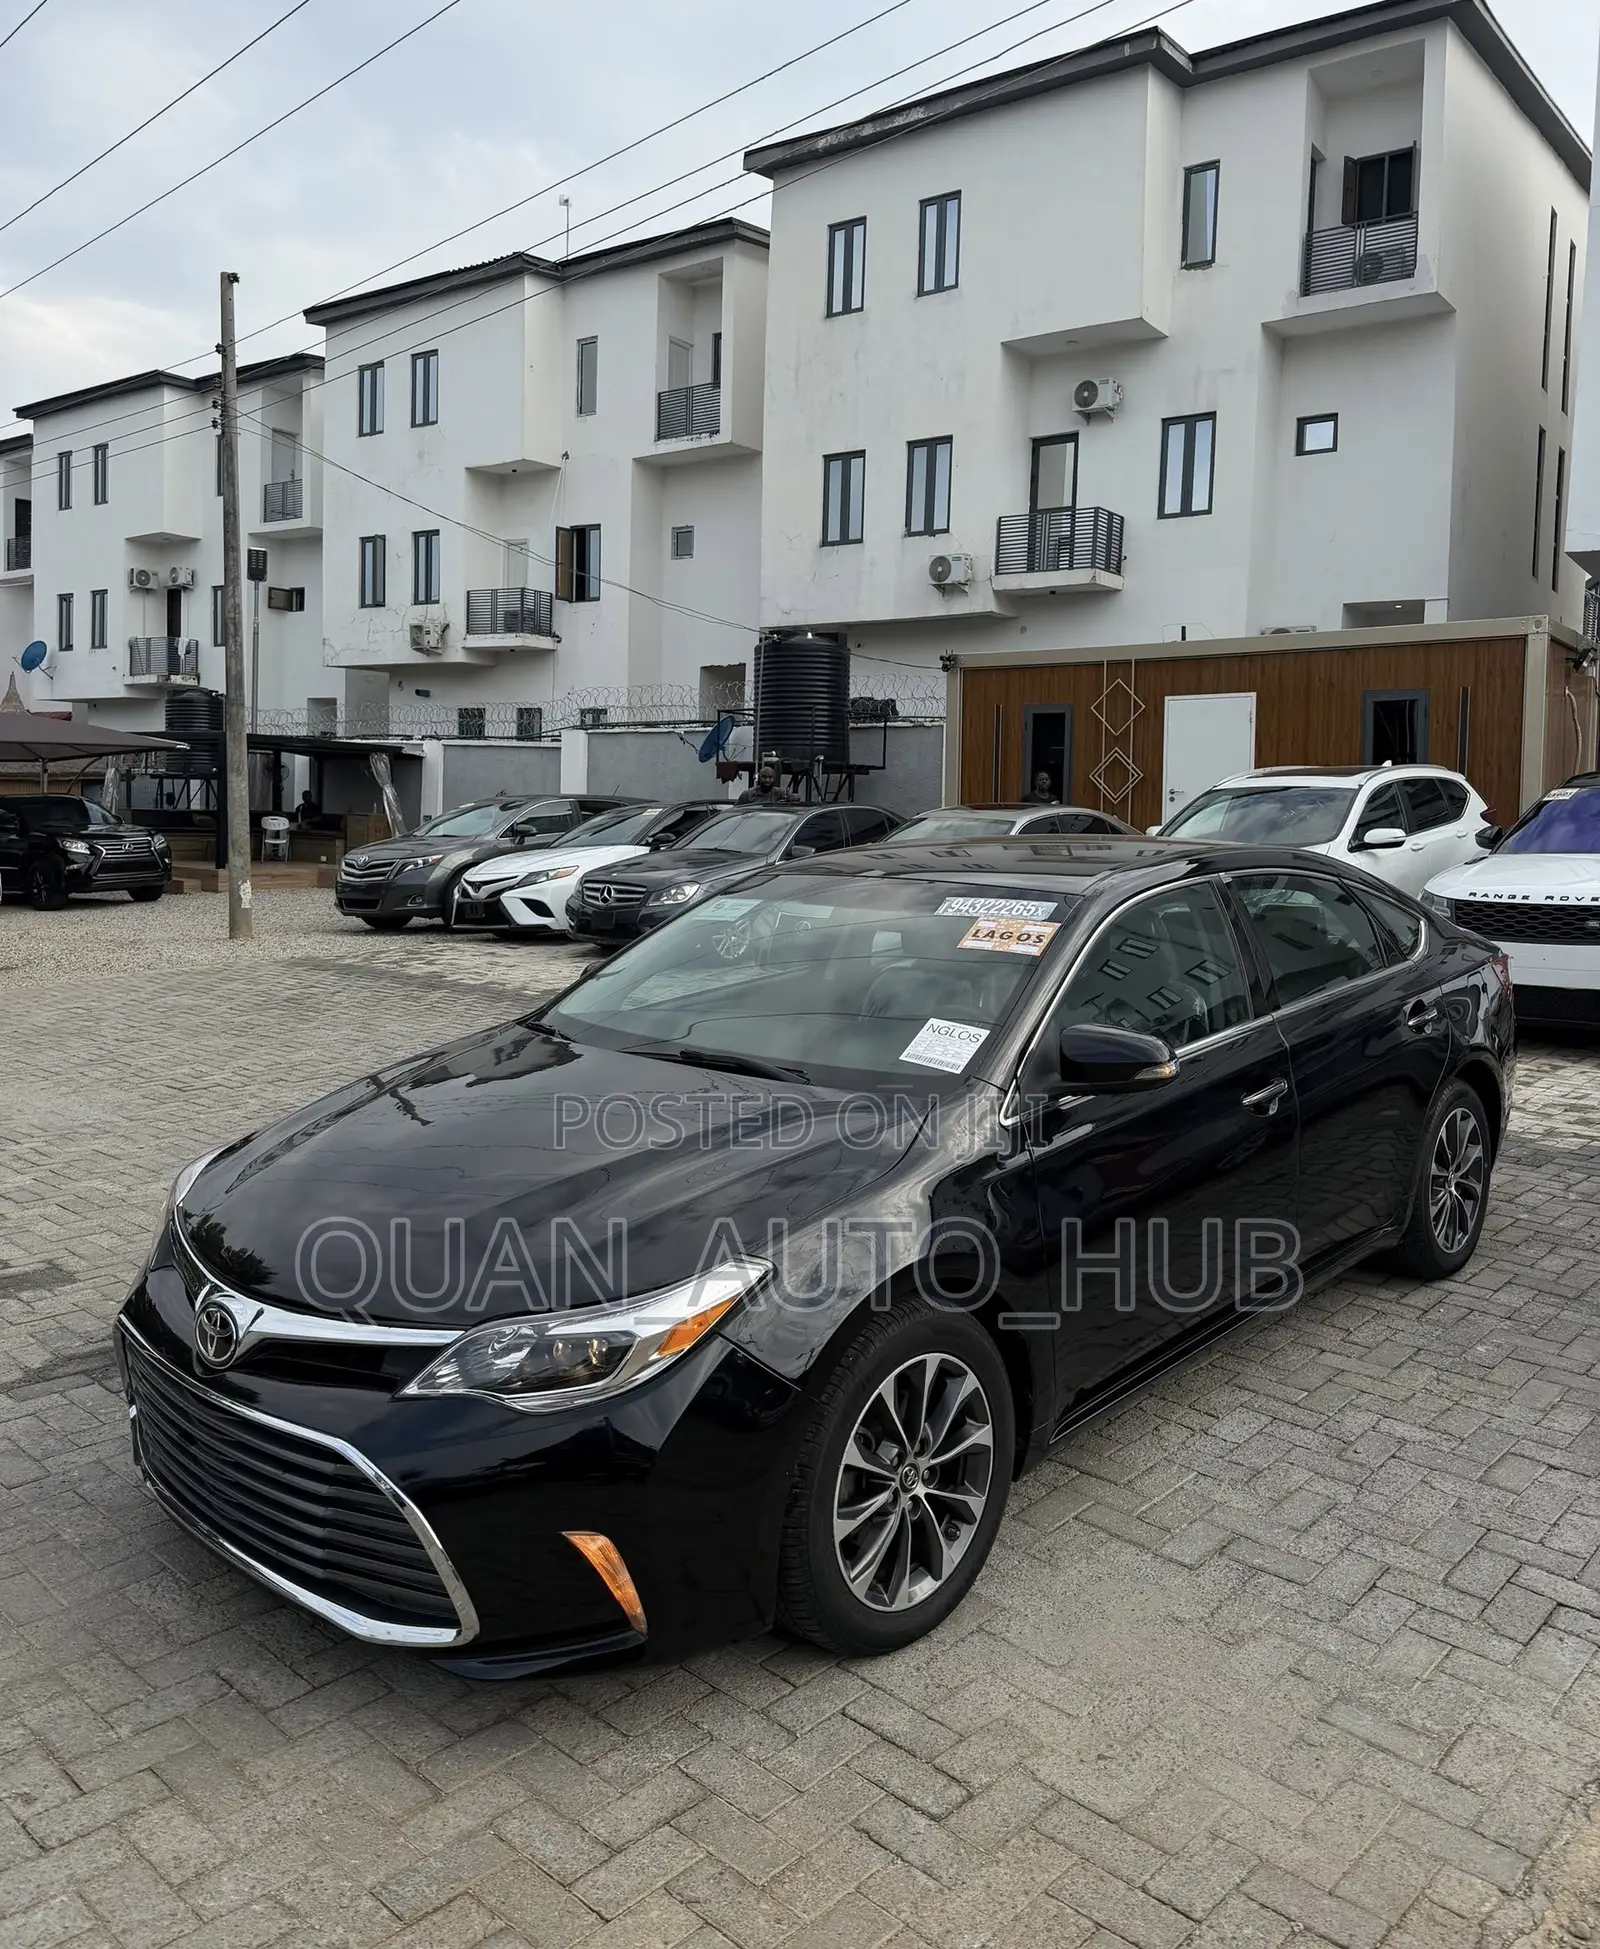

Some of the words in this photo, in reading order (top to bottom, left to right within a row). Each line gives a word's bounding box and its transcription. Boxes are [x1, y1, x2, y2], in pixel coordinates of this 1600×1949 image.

[1468, 891, 1531, 901] RANGE
[971, 928, 1046, 944] LAGOS
[916, 1023, 982, 1043] NGLOS
